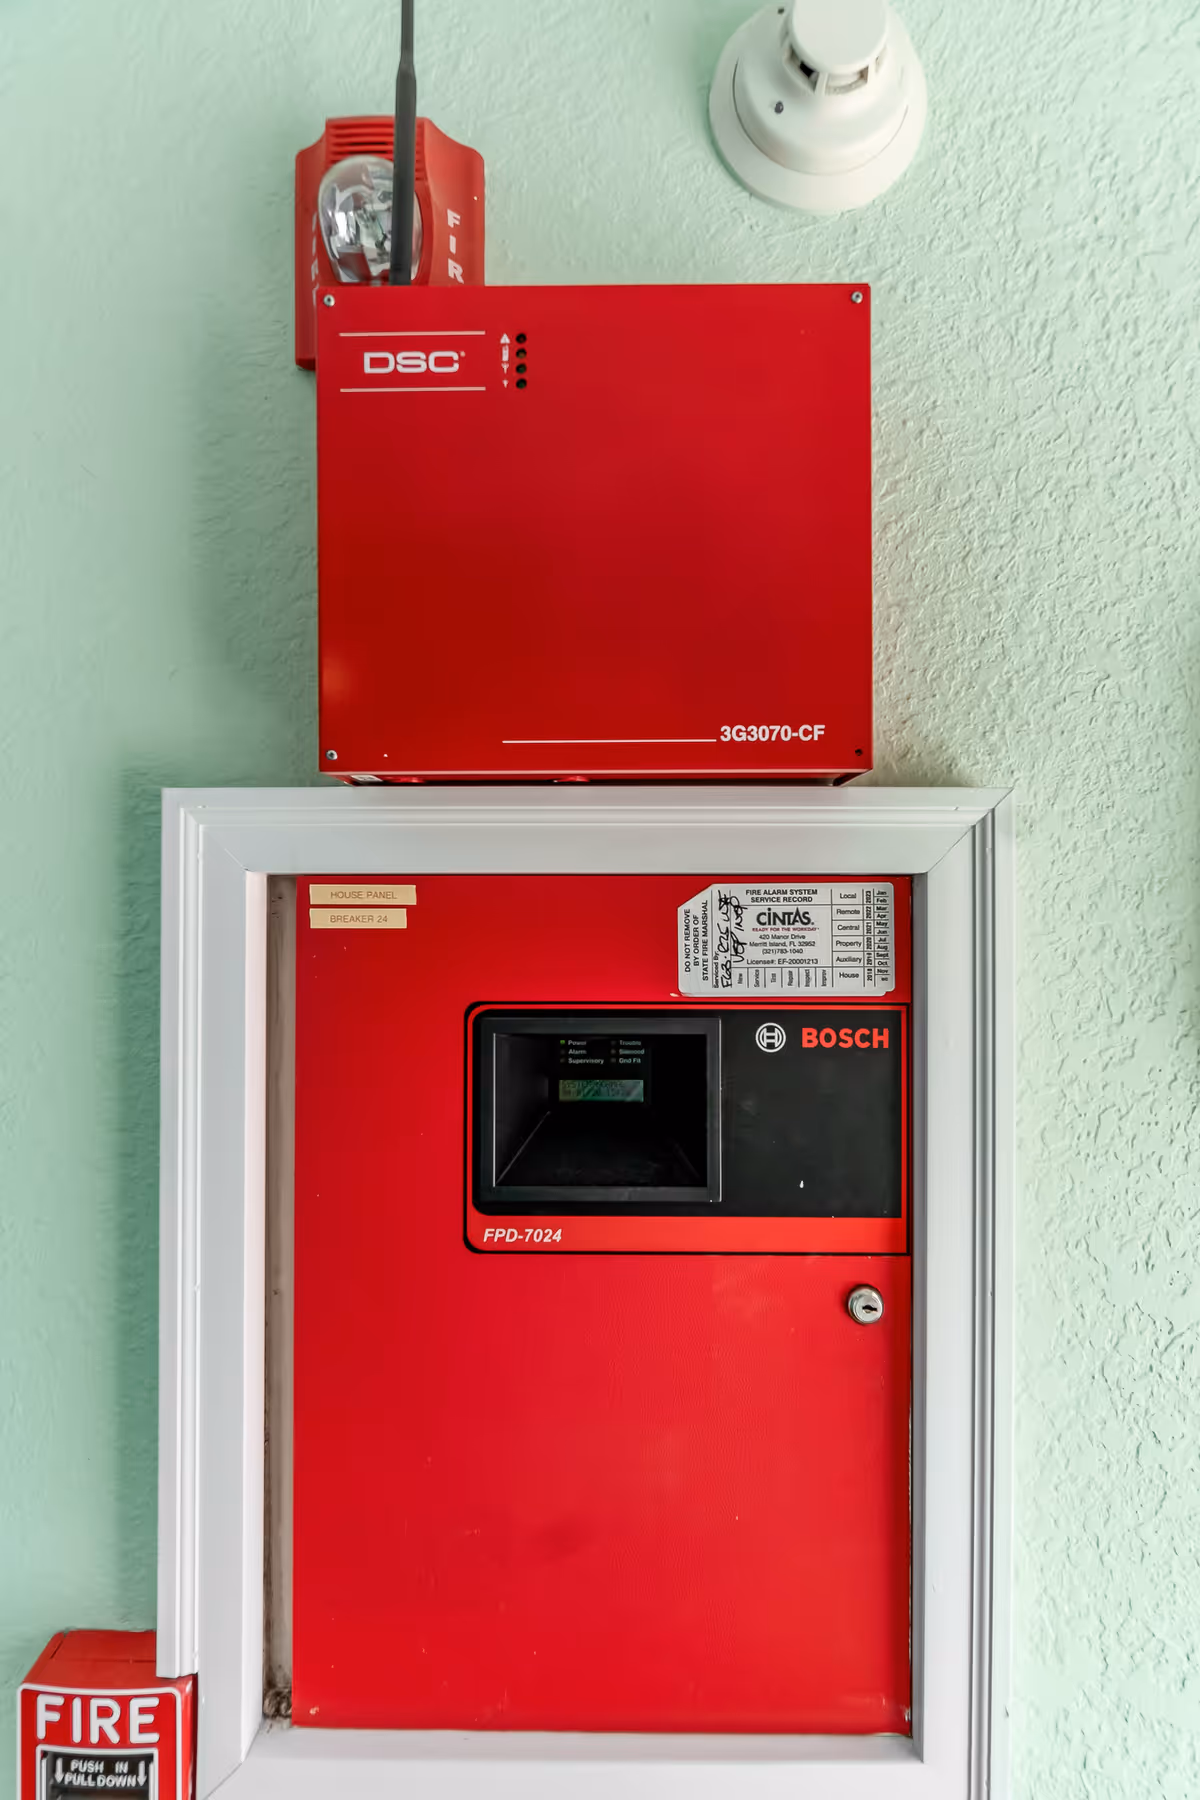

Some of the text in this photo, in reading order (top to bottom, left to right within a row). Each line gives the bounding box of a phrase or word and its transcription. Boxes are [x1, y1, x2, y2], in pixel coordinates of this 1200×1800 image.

[447, 208, 464, 284] FIR
[364, 351, 460, 374] DSC
[720, 724, 826, 742] 3G3070-CF
[330, 891, 398, 900] HOUSE PANEL
[330, 914, 388, 923] BREAKER 24
[692, 914, 700, 925] OF
[684, 961, 690, 972] DO
[692, 956, 700, 966] BY
[802, 1027, 889, 1048] BOSCH
[483, 1228, 562, 1242] FPD-7024
[36, 1694, 160, 1744] FIRE
[70, 1759, 128, 1774] PUSH IN
[64, 1772, 136, 1788] PULL DOWN
